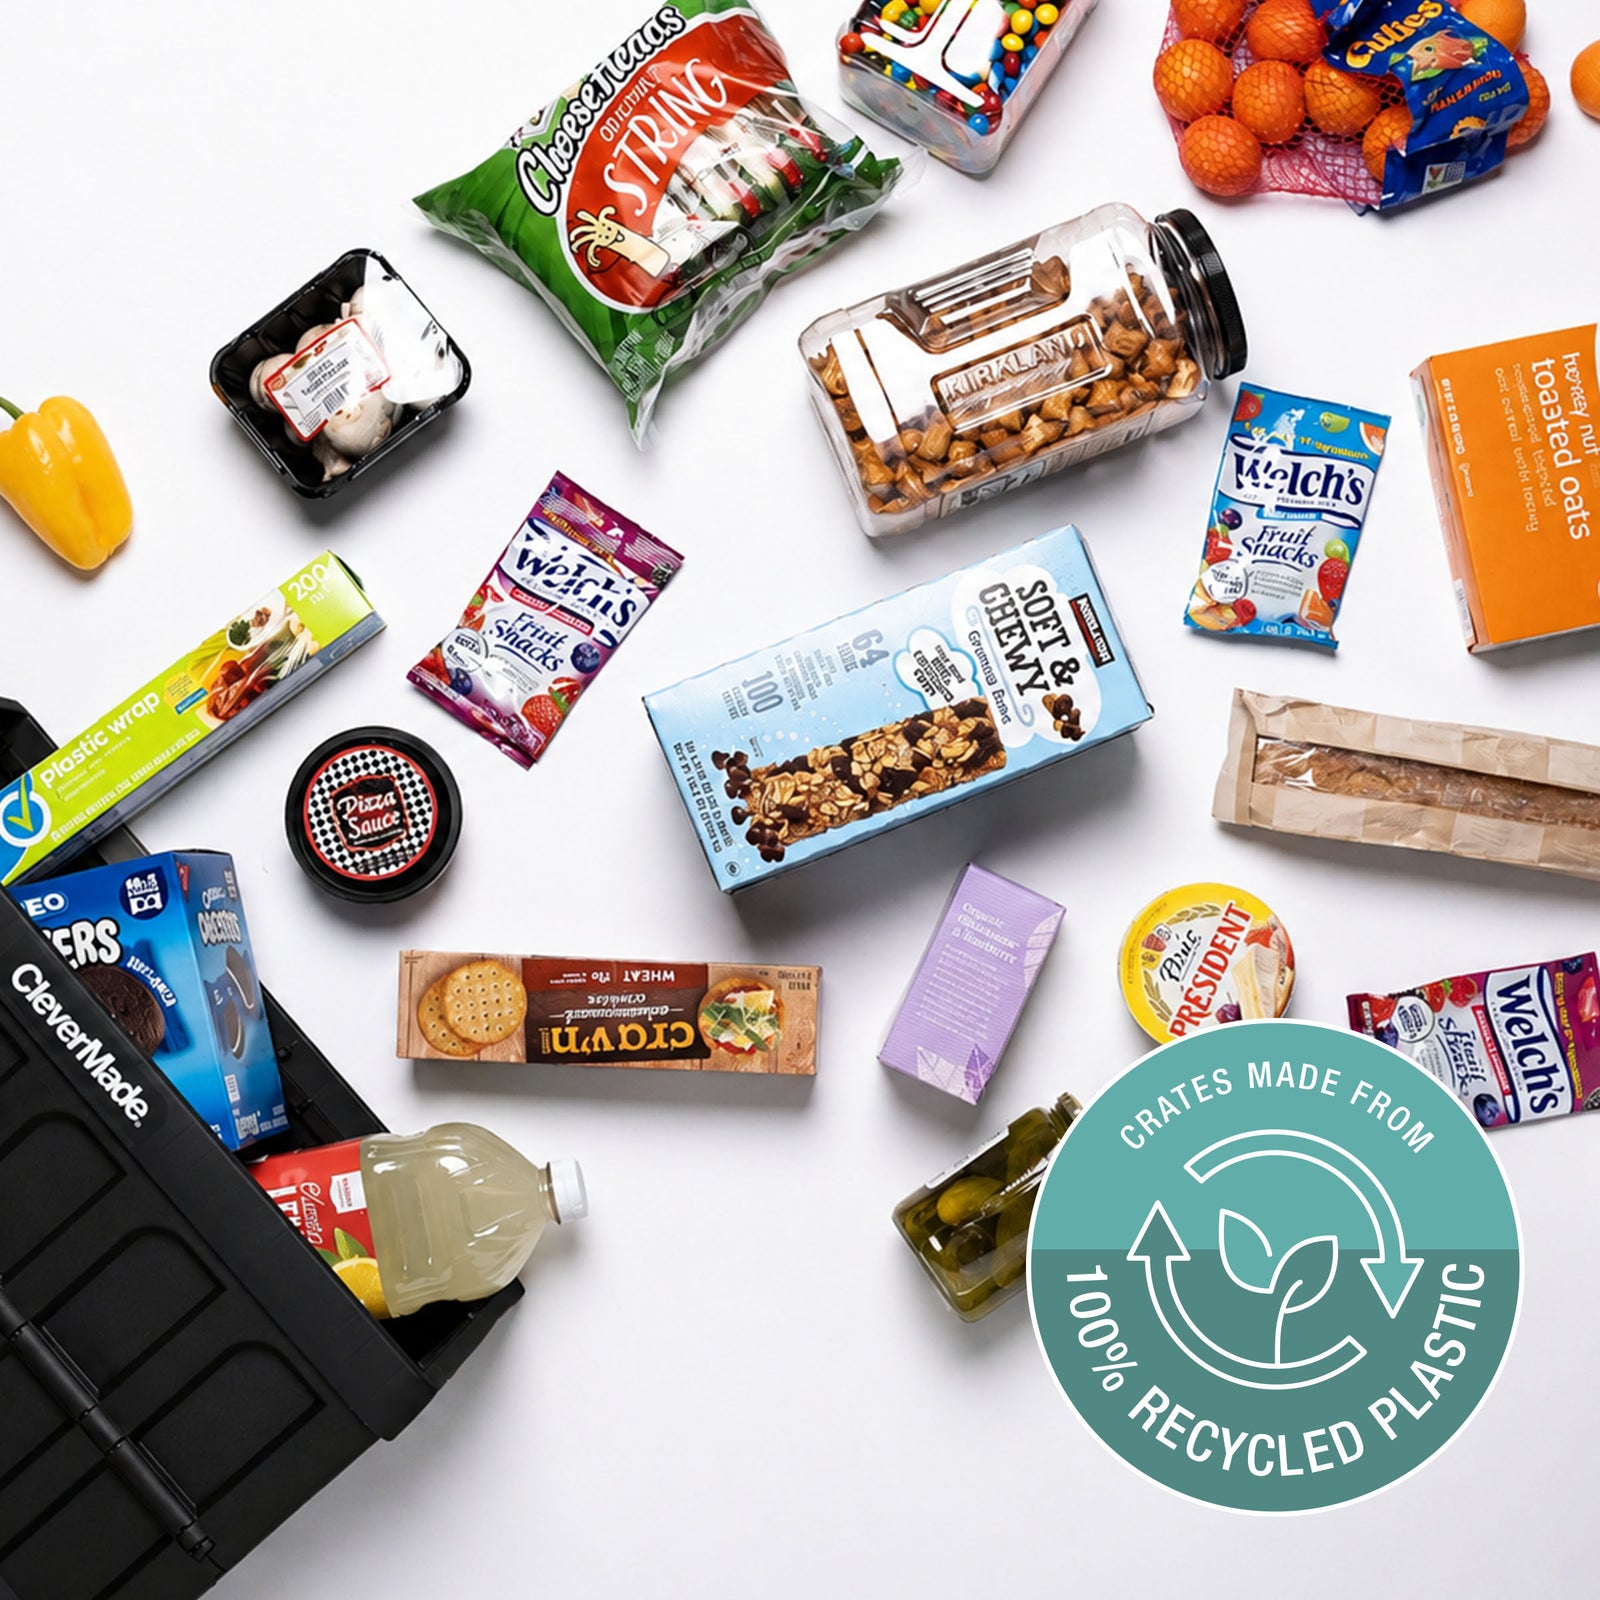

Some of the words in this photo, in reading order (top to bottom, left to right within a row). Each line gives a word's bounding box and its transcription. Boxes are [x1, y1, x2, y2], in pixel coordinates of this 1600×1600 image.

[603, 58, 728, 216] STRING
[1579, 423, 1600, 457] nut
[1559, 476, 1590, 540] oats
[287, 563, 330, 602] 200
[850, 628, 891, 670] 64
[978, 582, 1051, 697] CHEWY
[1015, 579, 1076, 652] SOFT
[1049, 655, 1083, 688] &
[106, 691, 161, 736] wrap
[741, 670, 786, 715] 100
[337, 791, 397, 821] Pizza
[347, 811, 401, 840] Sauce
[19, 893, 65, 918] EO
[41, 917, 122, 969] ERS
[623, 969, 675, 983] WHEAT
[11, 963, 150, 1122] CleverMade
[1496, 973, 1566, 1114] Welch's
